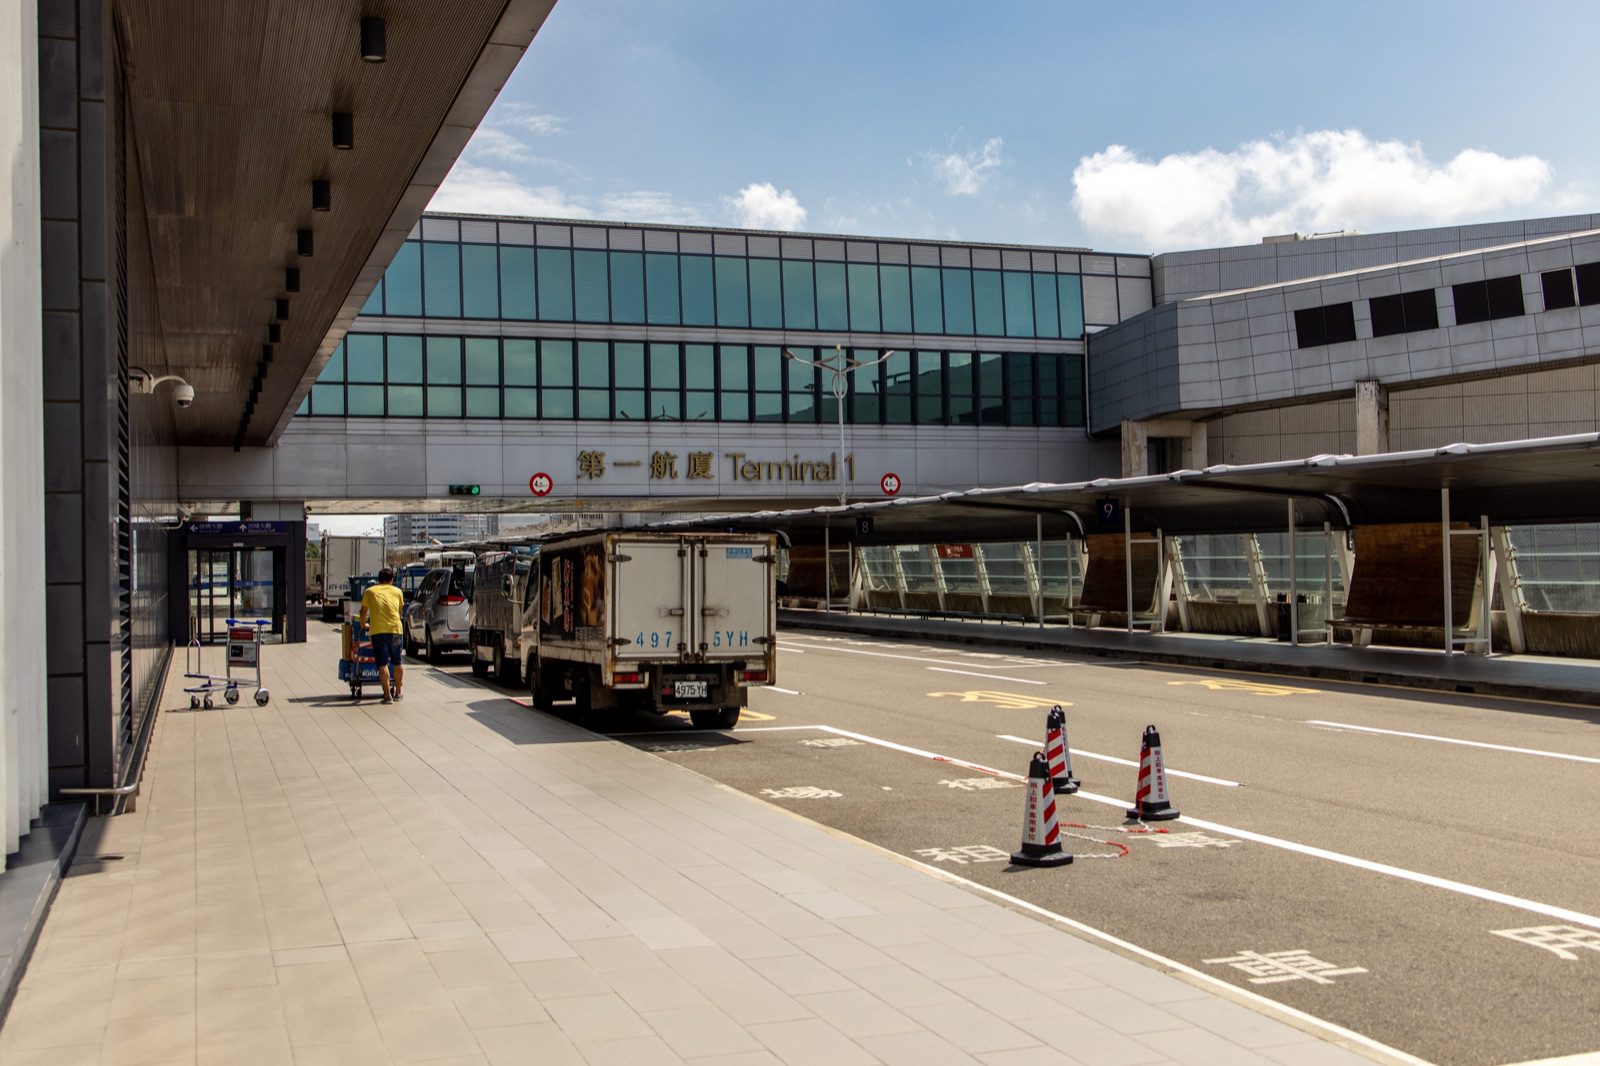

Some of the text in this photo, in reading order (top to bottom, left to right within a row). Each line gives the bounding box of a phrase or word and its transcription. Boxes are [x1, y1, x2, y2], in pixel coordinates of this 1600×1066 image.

[577, 451, 714, 480] 第一航廈
[725, 451, 856, 482] Terminal 1
[1104, 503, 1113, 519] 9
[862, 520, 869, 533] 8
